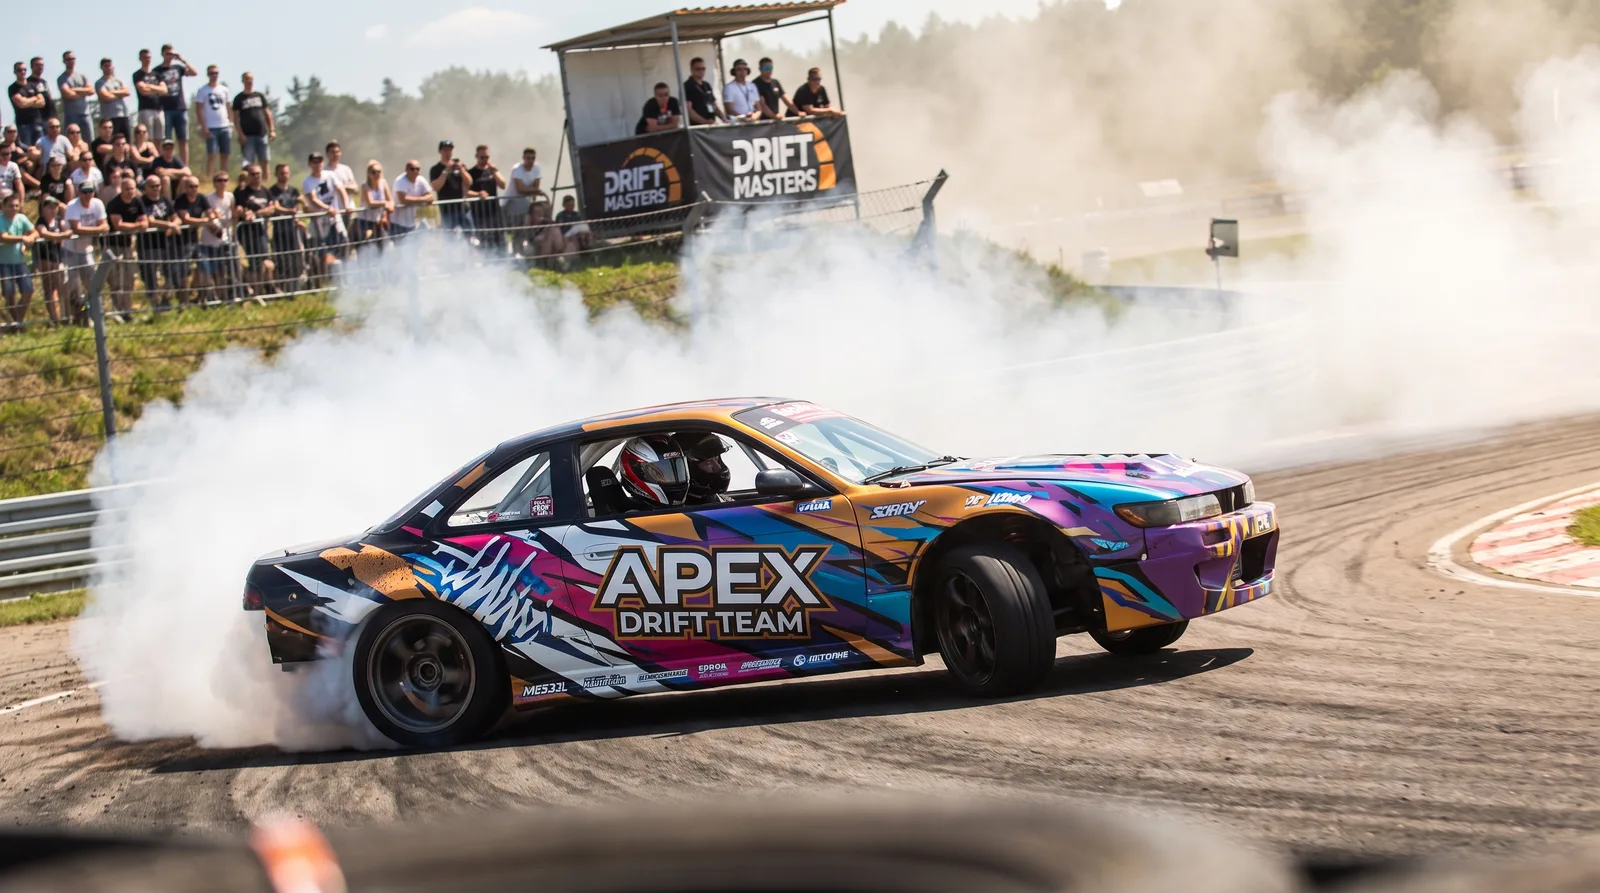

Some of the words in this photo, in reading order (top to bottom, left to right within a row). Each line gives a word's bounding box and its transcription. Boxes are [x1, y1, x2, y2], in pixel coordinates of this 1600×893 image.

[732, 132, 814, 175] DRIFT
[604, 162, 665, 195] DRIFT
[733, 168, 818, 200] MASTERS
[604, 187, 667, 213] MASTERS
[600, 552, 821, 605] APEX
[620, 611, 709, 634] DRIFT
[714, 611, 804, 634] TEAM
